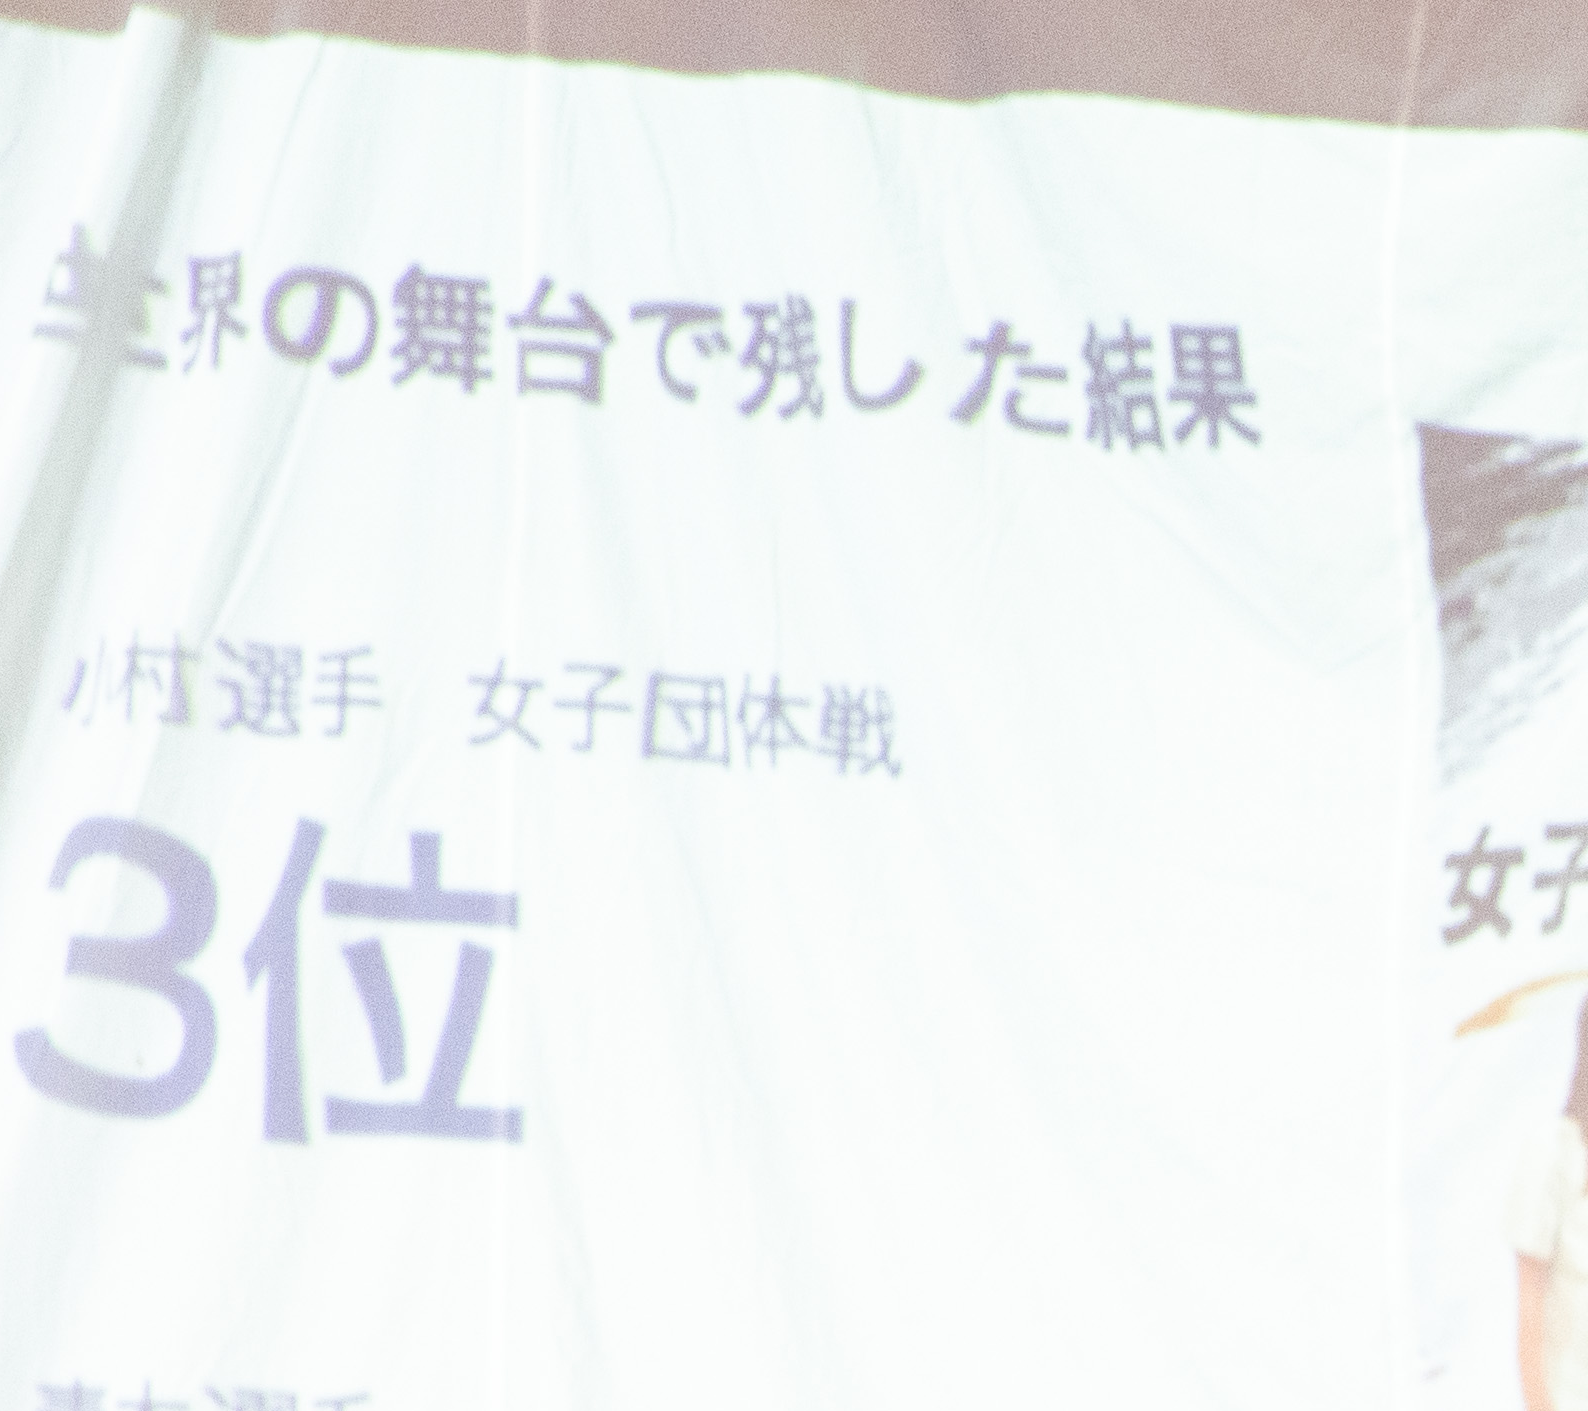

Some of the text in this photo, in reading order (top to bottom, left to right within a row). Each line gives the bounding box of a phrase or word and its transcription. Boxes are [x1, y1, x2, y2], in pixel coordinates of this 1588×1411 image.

[33, 222, 1262, 452] 世界の舞台で残した結果
[467, 659, 902, 780] 女子団体戦
[12, 815, 525, 1147] 3位
